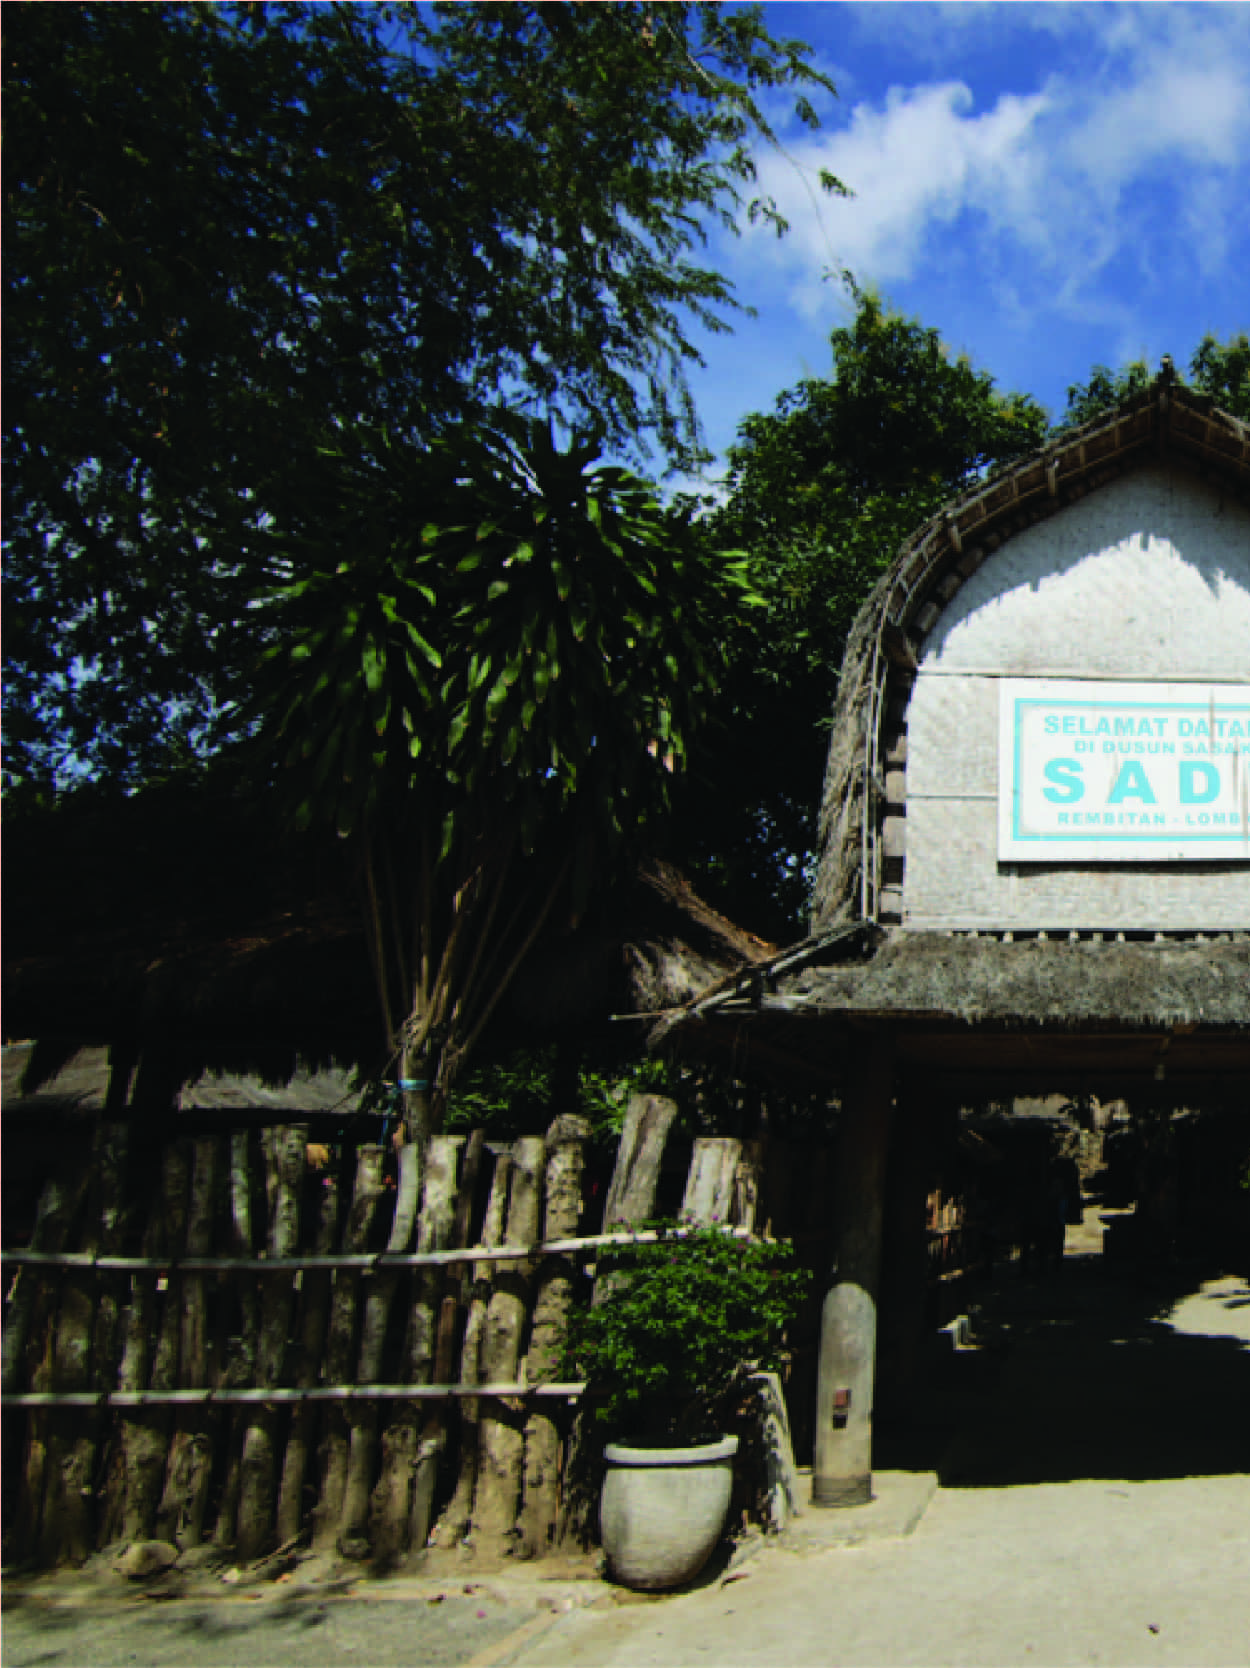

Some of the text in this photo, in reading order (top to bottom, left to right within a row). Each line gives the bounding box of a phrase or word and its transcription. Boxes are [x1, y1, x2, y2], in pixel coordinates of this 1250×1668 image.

[1044, 715, 1168, 737] SELAMAT
[1075, 740, 1094, 753] DI
[1103, 741, 1175, 754] DUSUN
[1058, 812, 1166, 825] REMBITAN
